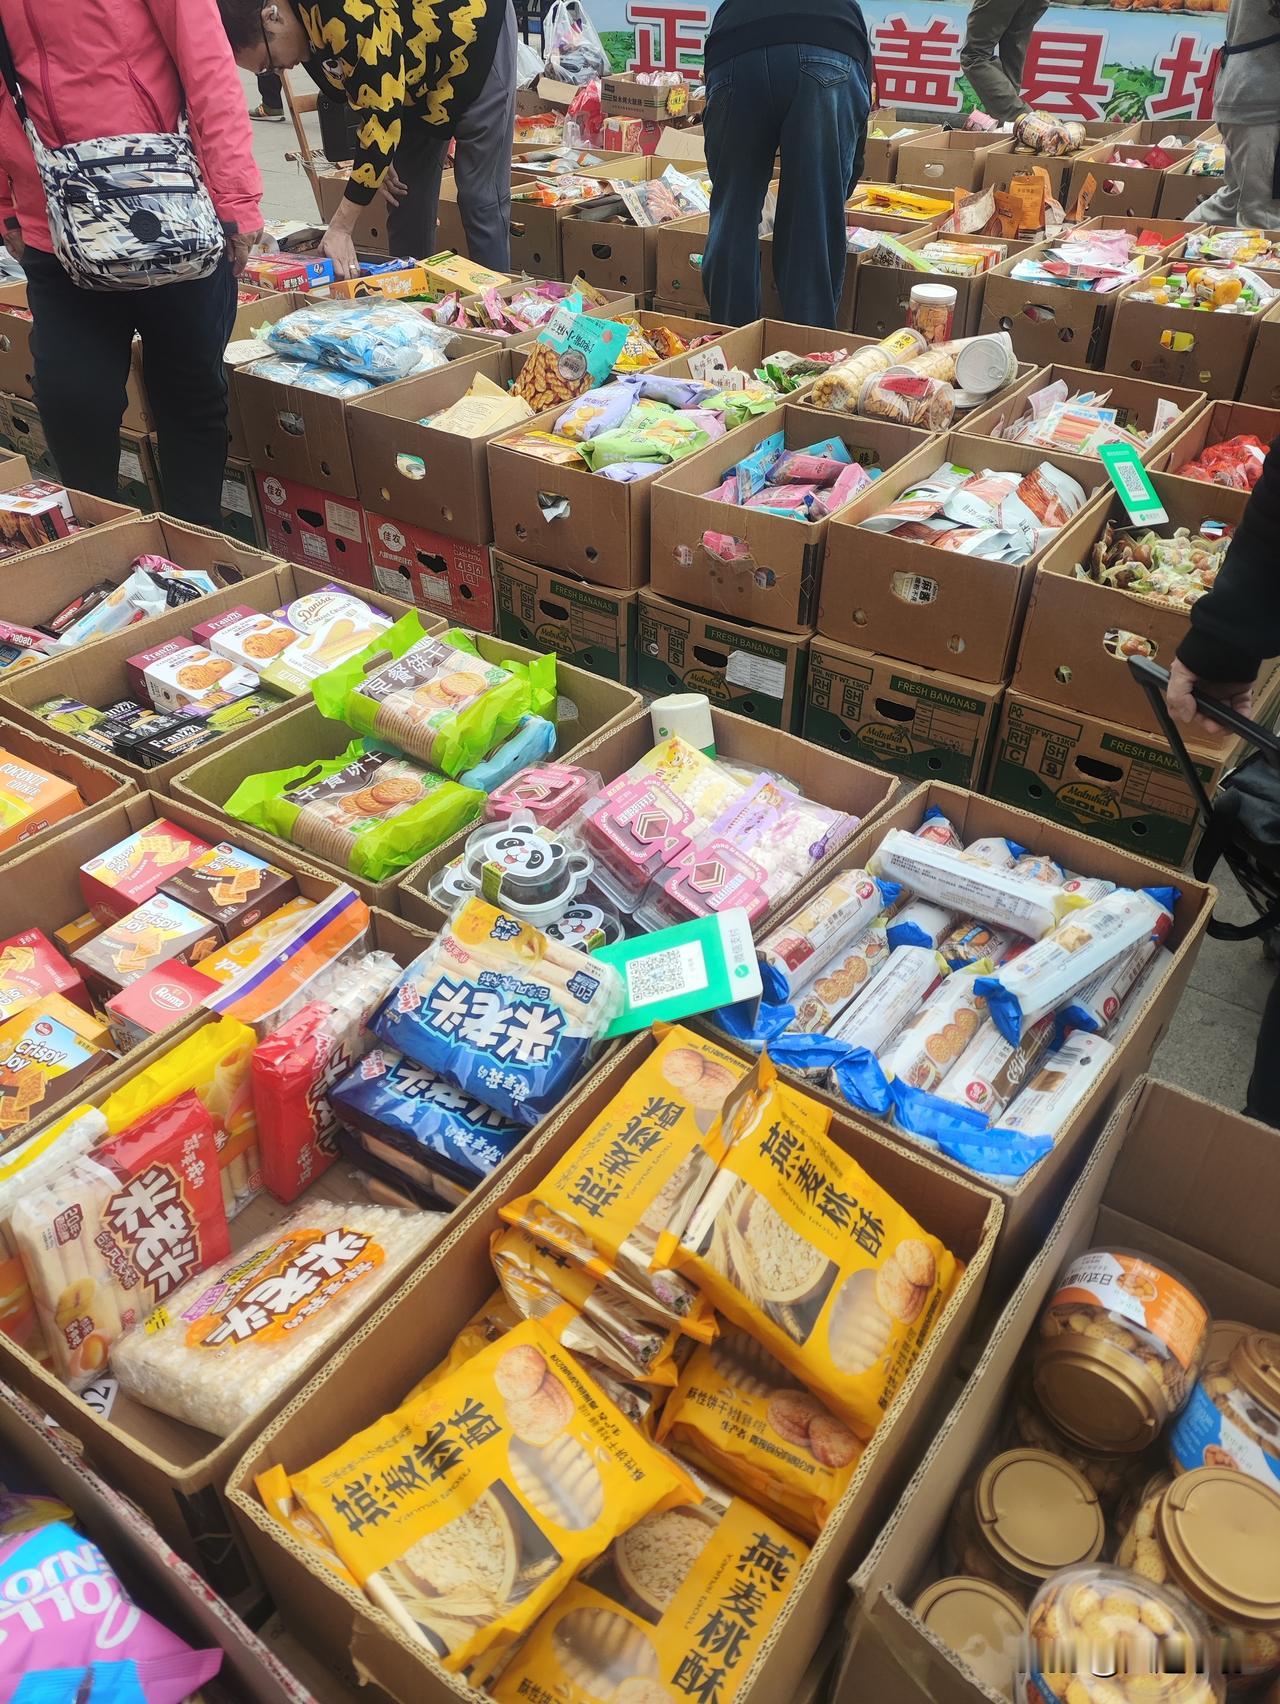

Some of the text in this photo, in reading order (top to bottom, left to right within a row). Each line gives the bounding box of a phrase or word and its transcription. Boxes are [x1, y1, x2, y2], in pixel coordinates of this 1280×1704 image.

[266, 484, 285, 499] 佳农
[382, 530, 400, 544] 佳农
[456, 560, 464, 569] 4
[467, 562, 474, 572] 5
[555, 585, 613, 612] FRESH BANANAS
[298, 596, 335, 623] Danisa
[207, 611, 242, 630] Franzzi
[642, 625, 657, 639] RH
[669, 636, 684, 649] SH
[142, 641, 179, 661] Franzzi
[710, 629, 781, 657] FRESH BANANAS
[366, 643, 446, 695] 早餐饼干
[671, 654, 681, 664] S
[814, 678, 830, 692] RH
[825, 671, 839, 682] NET
[851, 678, 870, 691] 13KG
[815, 694, 825, 705] C
[845, 687, 862, 702] SH
[897, 681, 977, 711] FRESH BANANAS
[846, 706, 856, 719] S
[149, 724, 203, 749] Franzzi
[861, 735, 908, 754] GOLD
[1009, 729, 1029, 745] RH
[1056, 736, 1077, 748] 13KG
[1009, 750, 1021, 762] C
[1048, 742, 1067, 761] SH
[1110, 739, 1204, 777] FRESH BANAS
[0, 762, 49, 786] COCONUT
[6, 780, 41, 797] COOKIE
[1062, 795, 1115, 817] GOLD
[105, 844, 136, 870] Crispy
[113, 859, 131, 875] Joy
[119, 918, 147, 935] Joy
[133, 909, 184, 932] Crispy
[155, 986, 185, 1008] Roma
[430, 982, 562, 1062] 米老头
[1, 1051, 32, 1073] Joy
[15, 1037, 67, 1066] Crispy
[567, 1096, 687, 1219] 燕麦桃酥
[760, 1121, 886, 1259] 燕麦桃酥
[109, 1170, 197, 1297] 米老头
[206, 1231, 368, 1343] 米老头
[721, 1419, 747, 1440] 生产者
[331, 1397, 503, 1538] 燕麦桃酥
[670, 1531, 797, 1704] 燕麦桃酥
